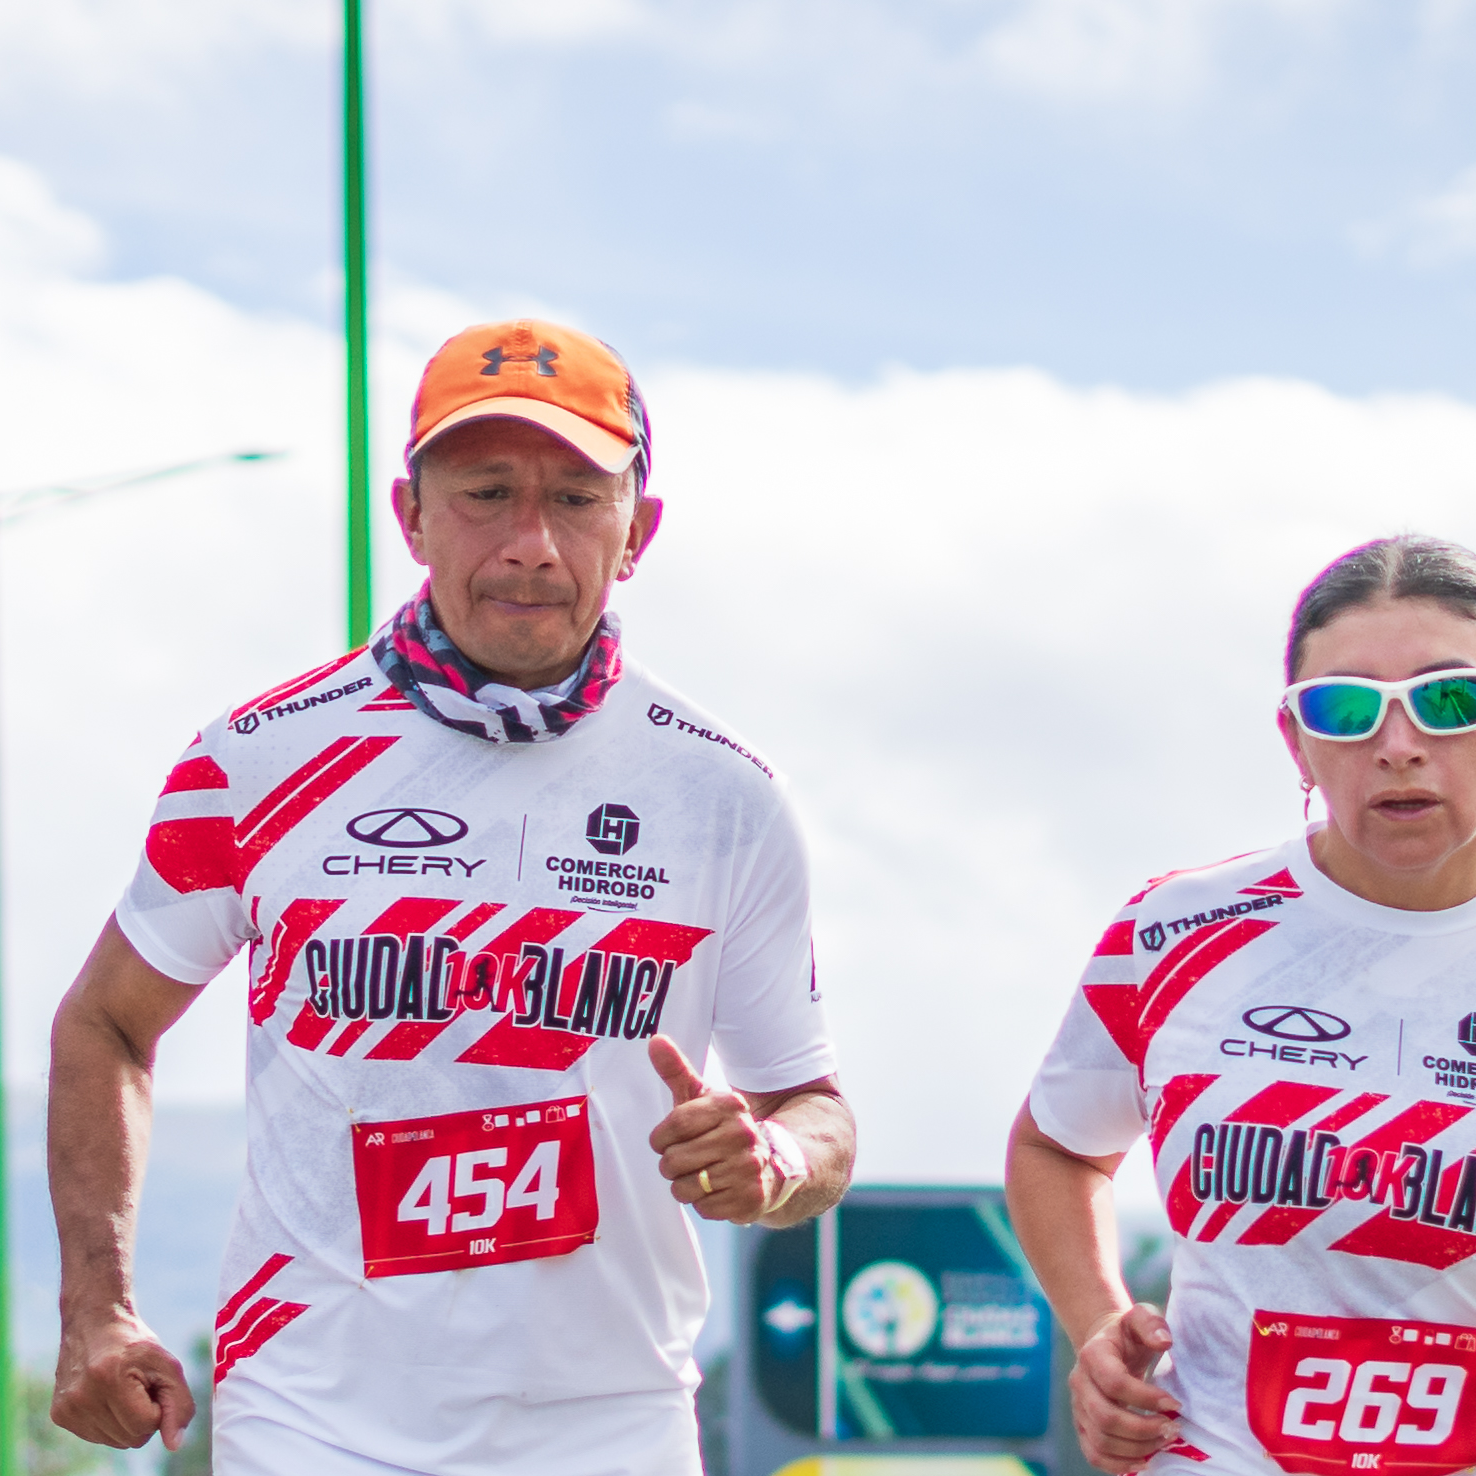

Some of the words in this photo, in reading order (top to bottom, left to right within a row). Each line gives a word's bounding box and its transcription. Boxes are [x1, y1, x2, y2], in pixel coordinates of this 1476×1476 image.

[261, 676, 374, 721] THUNDER
[676, 718, 774, 780] THUNDER
[322, 855, 487, 878] CHERY
[545, 856, 670, 884] COMERCIAL
[558, 875, 655, 899] HIDROBO
[1167, 894, 1284, 935] THUNDER
[304, 933, 458, 1022] CIUDAD
[444, 951, 539, 1016] 10K
[513, 942, 677, 1041] BLANCA
[1220, 1039, 1369, 1071] CHERY
[1190, 1122, 1342, 1209] CIUDAD
[1324, 1147, 1421, 1209] 10K
[397, 1140, 561, 1236] 454
[469, 1238, 497, 1255] 10K
[1281, 1357, 1468, 1446] 269
[1351, 1452, 1381, 1470] 10K
